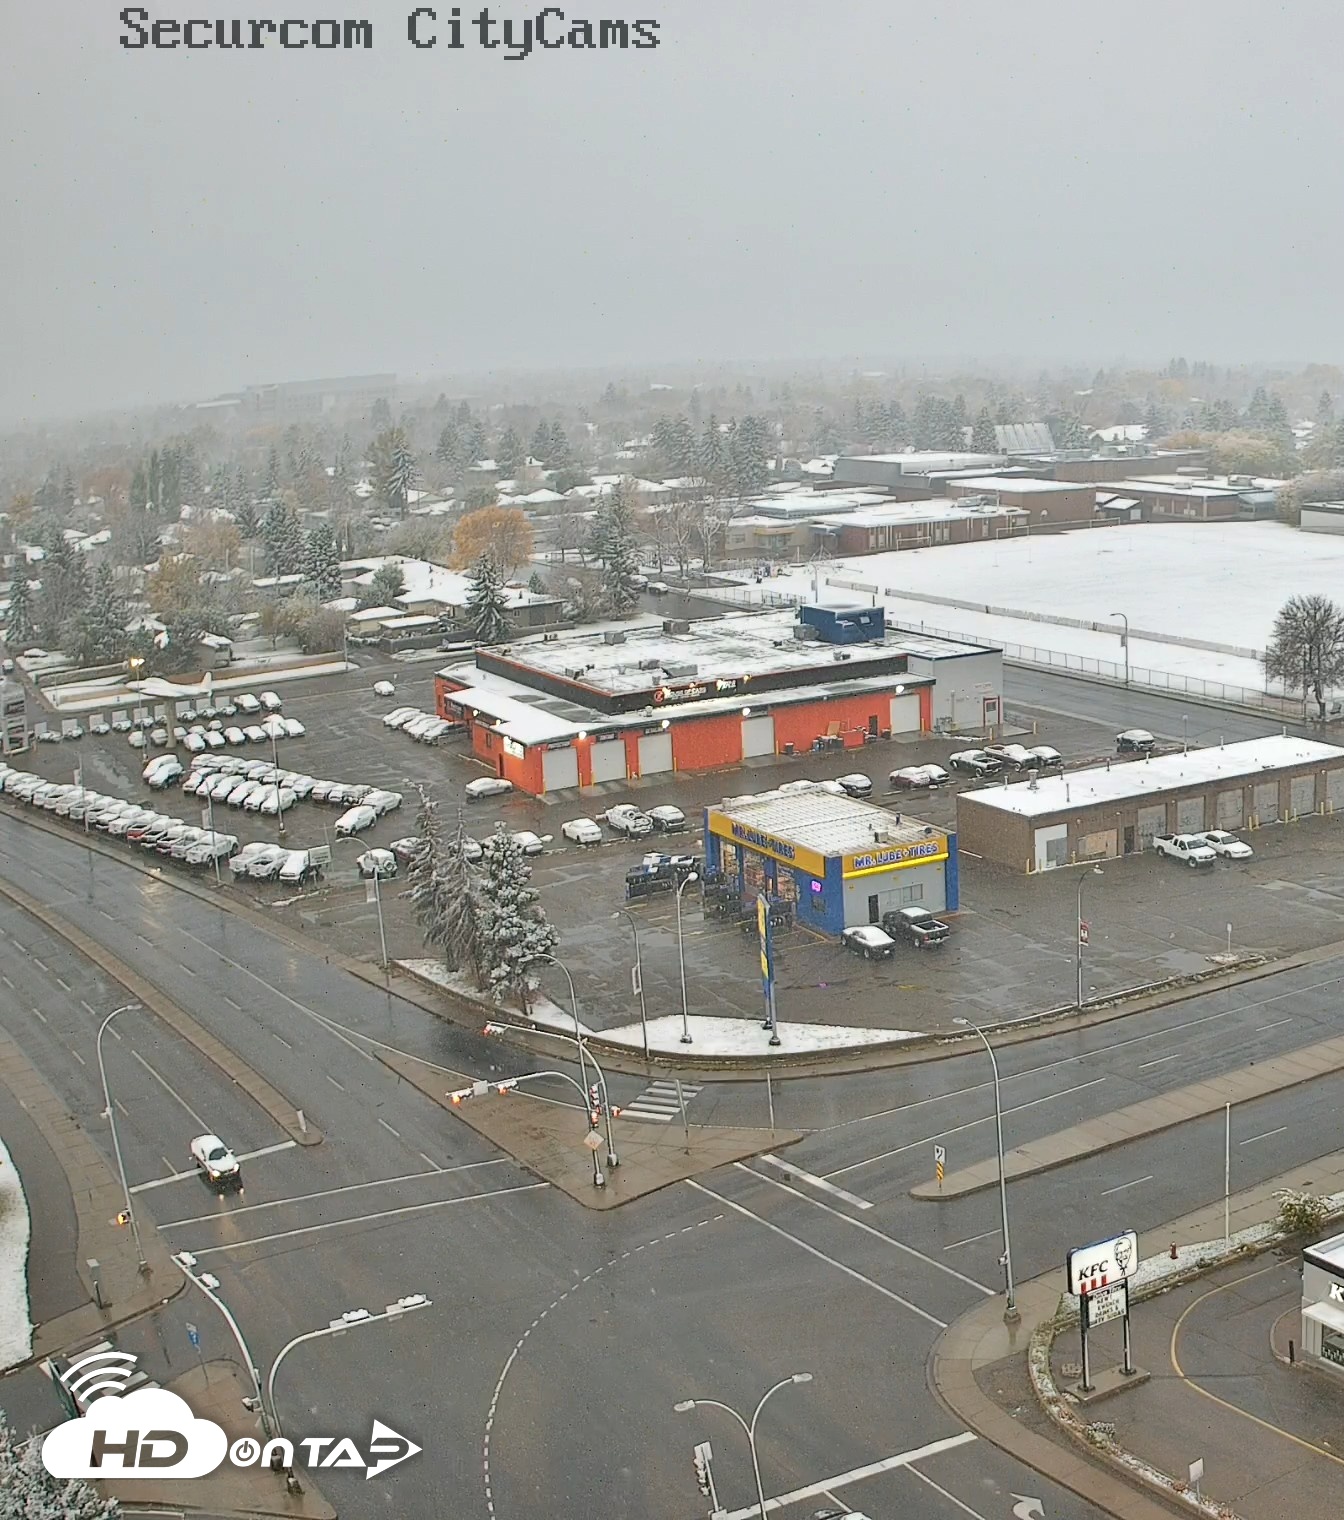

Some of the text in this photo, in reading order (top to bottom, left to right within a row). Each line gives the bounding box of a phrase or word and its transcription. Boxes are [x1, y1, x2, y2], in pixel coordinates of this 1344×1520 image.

[854, 855, 877, 869] MR.
[876, 849, 903, 864] LUBE
[909, 841, 939, 858] TIRES
[1078, 1260, 1109, 1281] KFC
